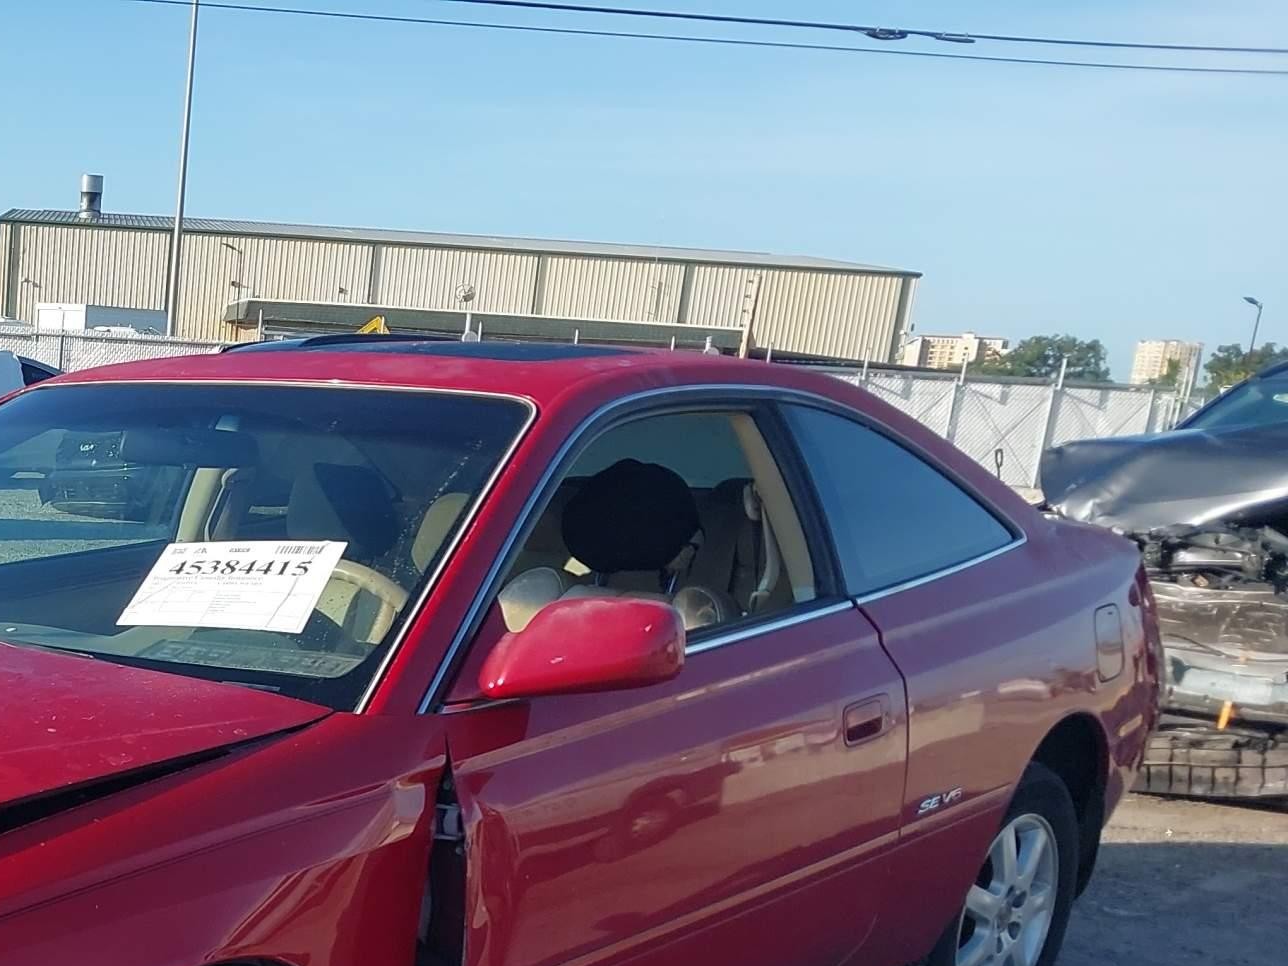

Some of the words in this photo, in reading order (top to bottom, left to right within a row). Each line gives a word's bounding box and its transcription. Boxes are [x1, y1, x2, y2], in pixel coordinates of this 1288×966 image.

[169, 560, 312, 576] 45384415
[918, 796, 941, 814] SE
[942, 787, 962, 803] V6
